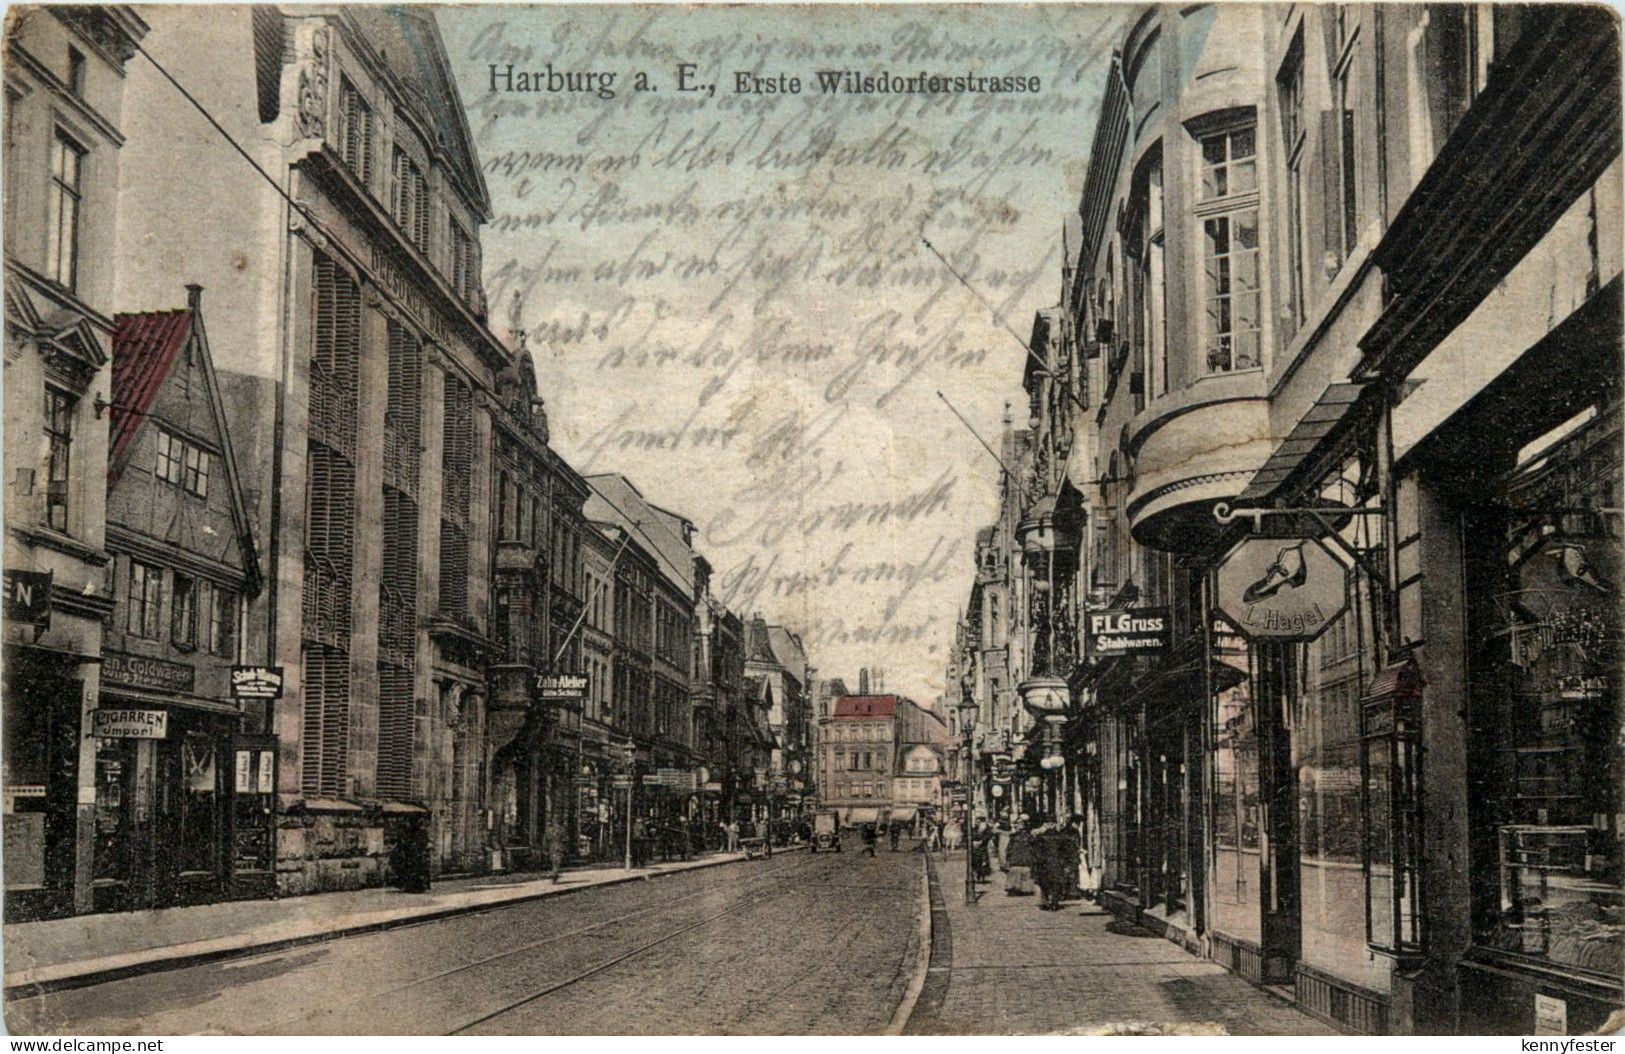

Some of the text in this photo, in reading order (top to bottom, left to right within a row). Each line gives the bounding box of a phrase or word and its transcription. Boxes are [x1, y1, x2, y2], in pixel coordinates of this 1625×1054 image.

[488, 64, 1040, 98] Harburg a. E., Erste Wilsdorferstrasse
[1264, 602, 1325, 636] Hagel
[1096, 634, 1163, 652] Stahlwaren.
[97, 710, 165, 730] CIGARREN
